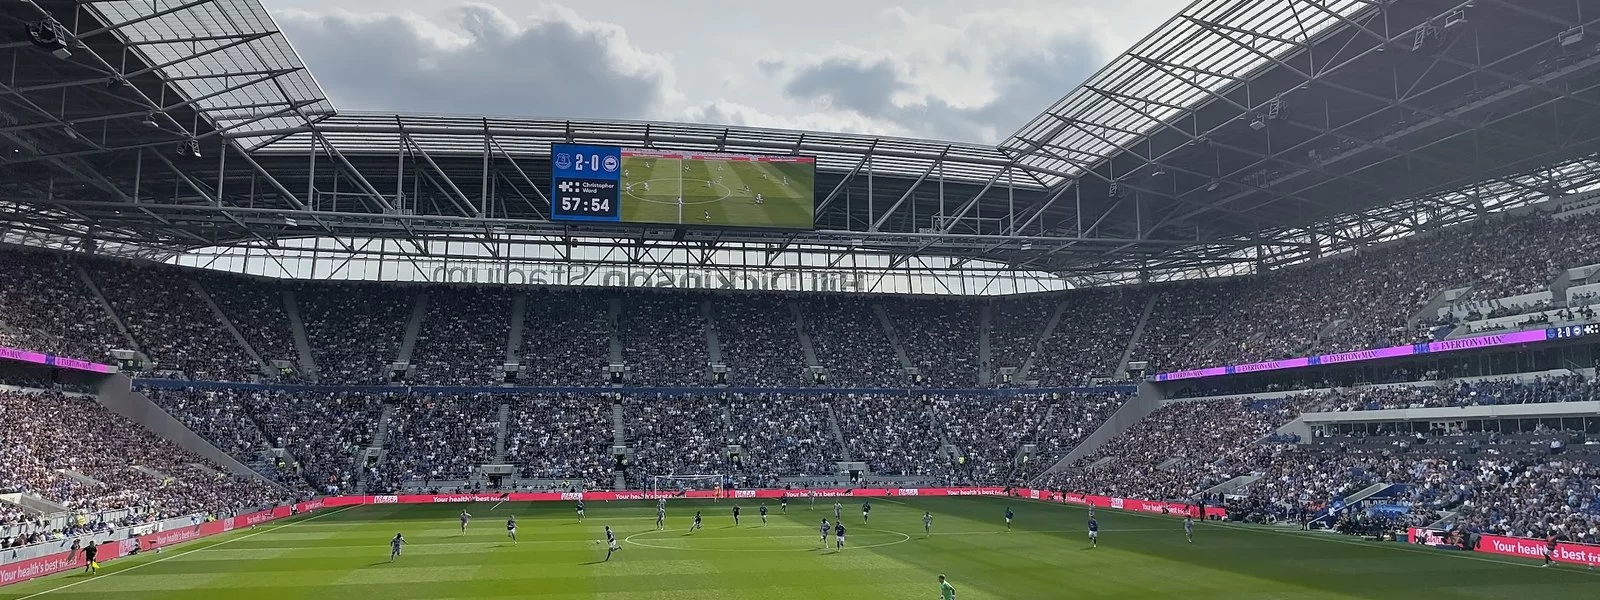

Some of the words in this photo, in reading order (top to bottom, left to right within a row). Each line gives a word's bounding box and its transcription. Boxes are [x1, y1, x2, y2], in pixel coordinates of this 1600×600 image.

[562, 197, 610, 212] 57:54
[1441, 338, 1479, 350] EVERTON
[1329, 353, 1358, 363] EVERTON
[1242, 364, 1266, 372] EVERTON
[1493, 539, 1516, 552] Your
[1517, 542, 1560, 557] healths
[1561, 547, 1586, 561] best
[0, 569, 17, 582] Your
[18, 562, 44, 578] health's
[45, 560, 58, 571] best
